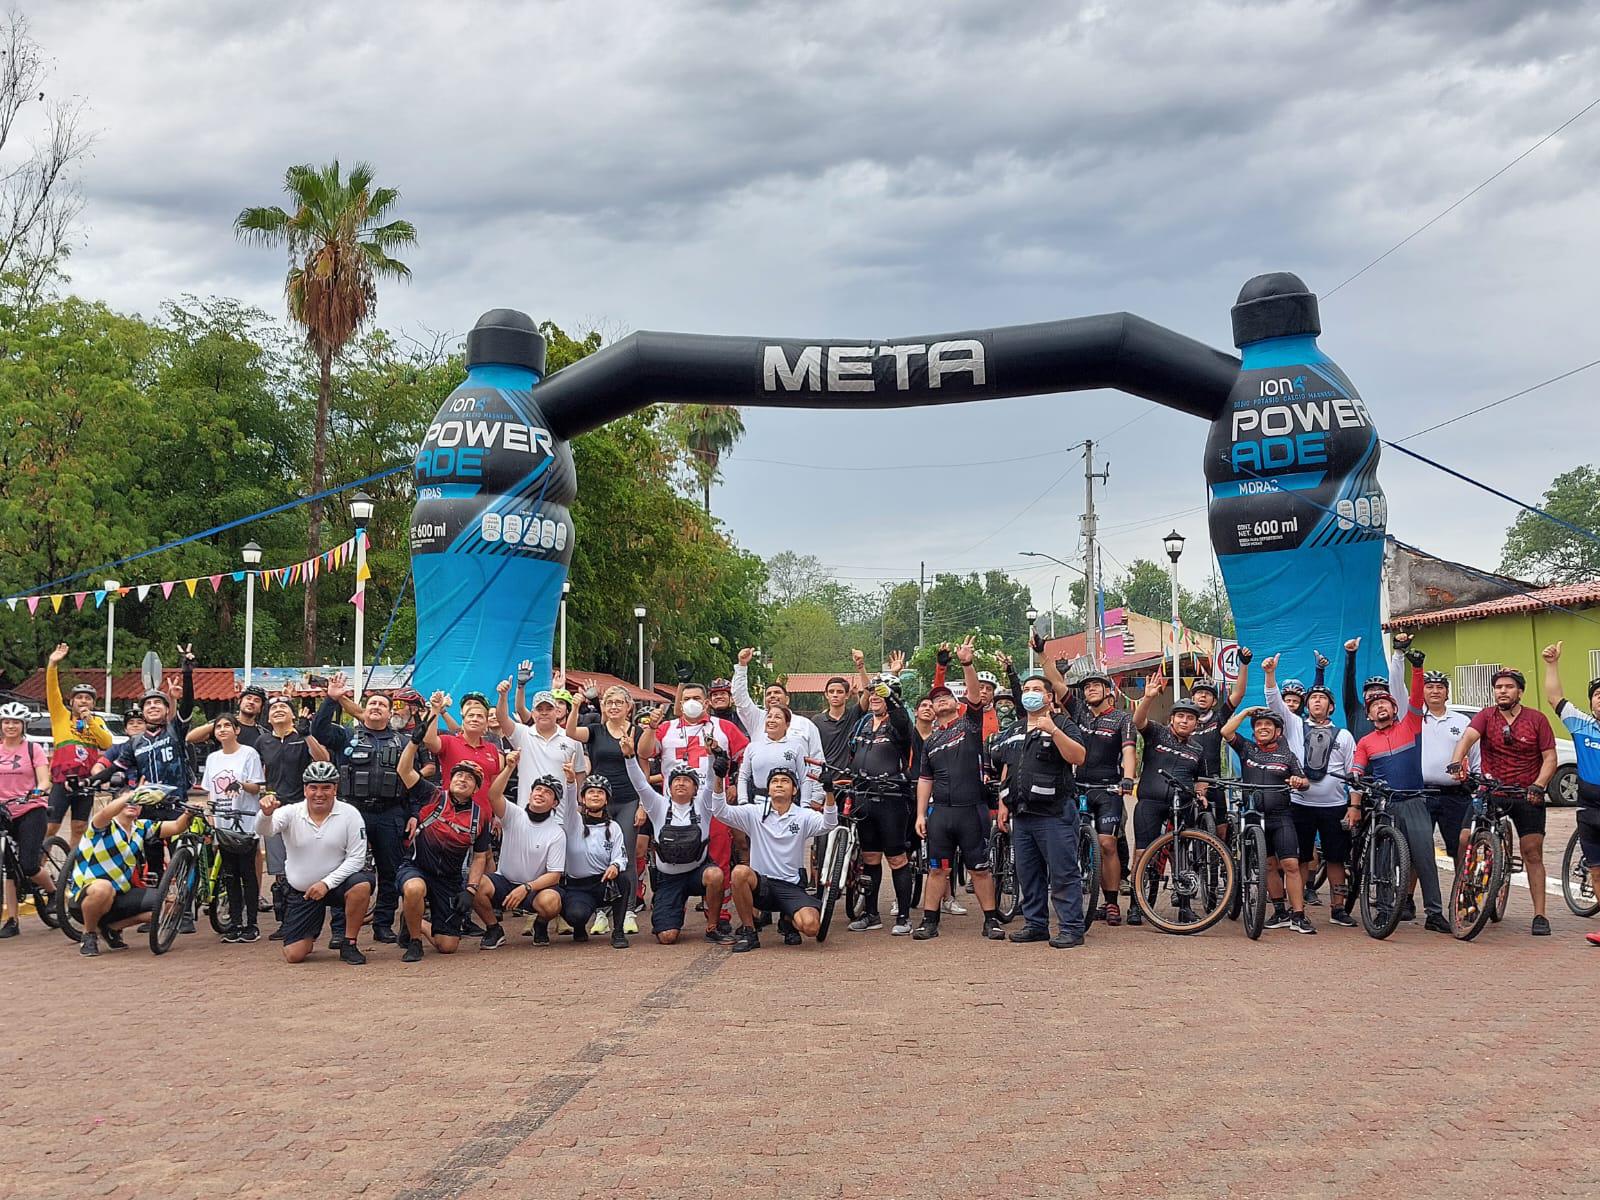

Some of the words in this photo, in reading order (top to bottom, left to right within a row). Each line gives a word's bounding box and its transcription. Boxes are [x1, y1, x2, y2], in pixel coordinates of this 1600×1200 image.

[763, 339, 986, 392] META
[1231, 399, 1374, 442] POWER
[420, 420, 555, 458] POWER
[1231, 431, 1328, 473] ADE
[416, 448, 485, 479] ADE
[417, 523, 433, 538] 600
[433, 522, 446, 537] ml
[1254, 520, 1279, 536] 600
[1281, 516, 1298, 533] ml
[160, 746, 174, 762] 16
